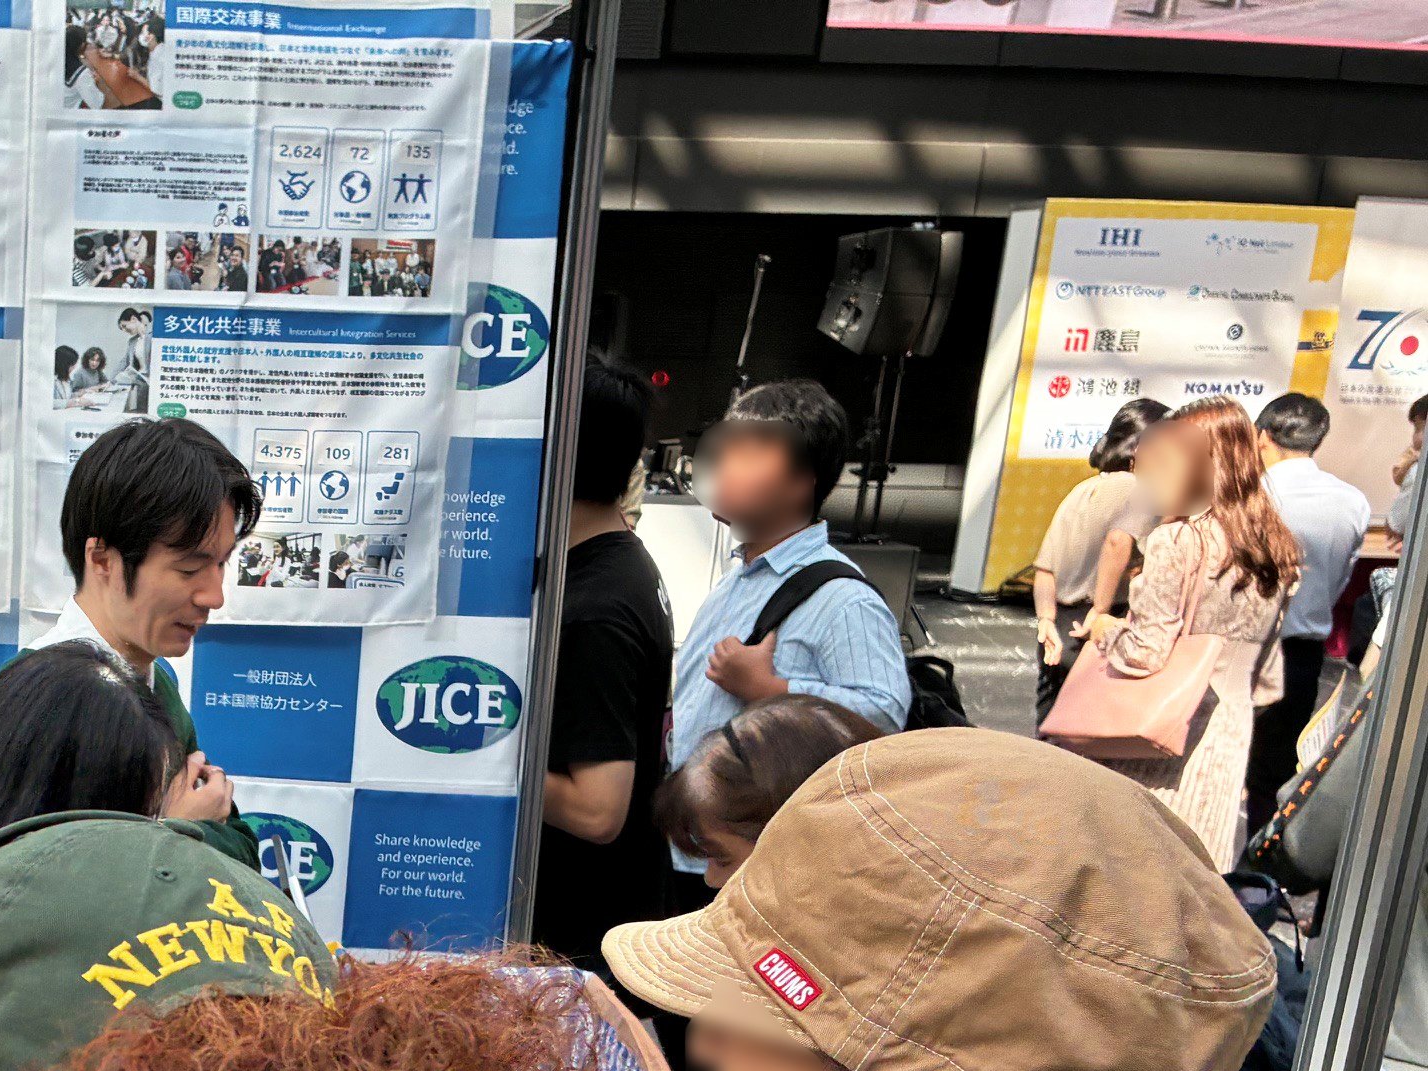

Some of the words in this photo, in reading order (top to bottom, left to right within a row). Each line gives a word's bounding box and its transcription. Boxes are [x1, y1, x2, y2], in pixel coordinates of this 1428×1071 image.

[176, 6, 282, 30] 国際交流事業
[350, 146, 370, 160] 72
[406, 144, 431, 159] 135
[1099, 227, 1143, 246] IHI
[163, 314, 283, 338] 多文化共生事業
[462, 312, 532, 359] CE
[1184, 380, 1264, 396] KOMATSU
[1044, 428, 1105, 450] 清水建
[260, 444, 302, 459] 4,375
[326, 447, 351, 460] 109
[383, 446, 410, 460] 281
[444, 490, 506, 506] nowledge
[442, 511, 499, 525] perience.
[452, 528, 492, 541] world.
[449, 545, 492, 559] future.
[233, 670, 317, 688] 一般財団法人
[205, 692, 343, 712] 日本国際協力センター
[394, 682, 509, 732] JICE
[375, 833, 410, 847] Share
[413, 834, 481, 851] knowledge
[258, 837, 318, 881] CE
[377, 851, 401, 863] and
[404, 852, 475, 868] experience.
[381, 867, 401, 880] For
[404, 870, 425, 881] our
[427, 869, 466, 883] world.
[379, 884, 399, 896] For
[401, 884, 421, 897] the
[423, 885, 465, 900] future.
[759, 953, 814, 1005] CHUMS
